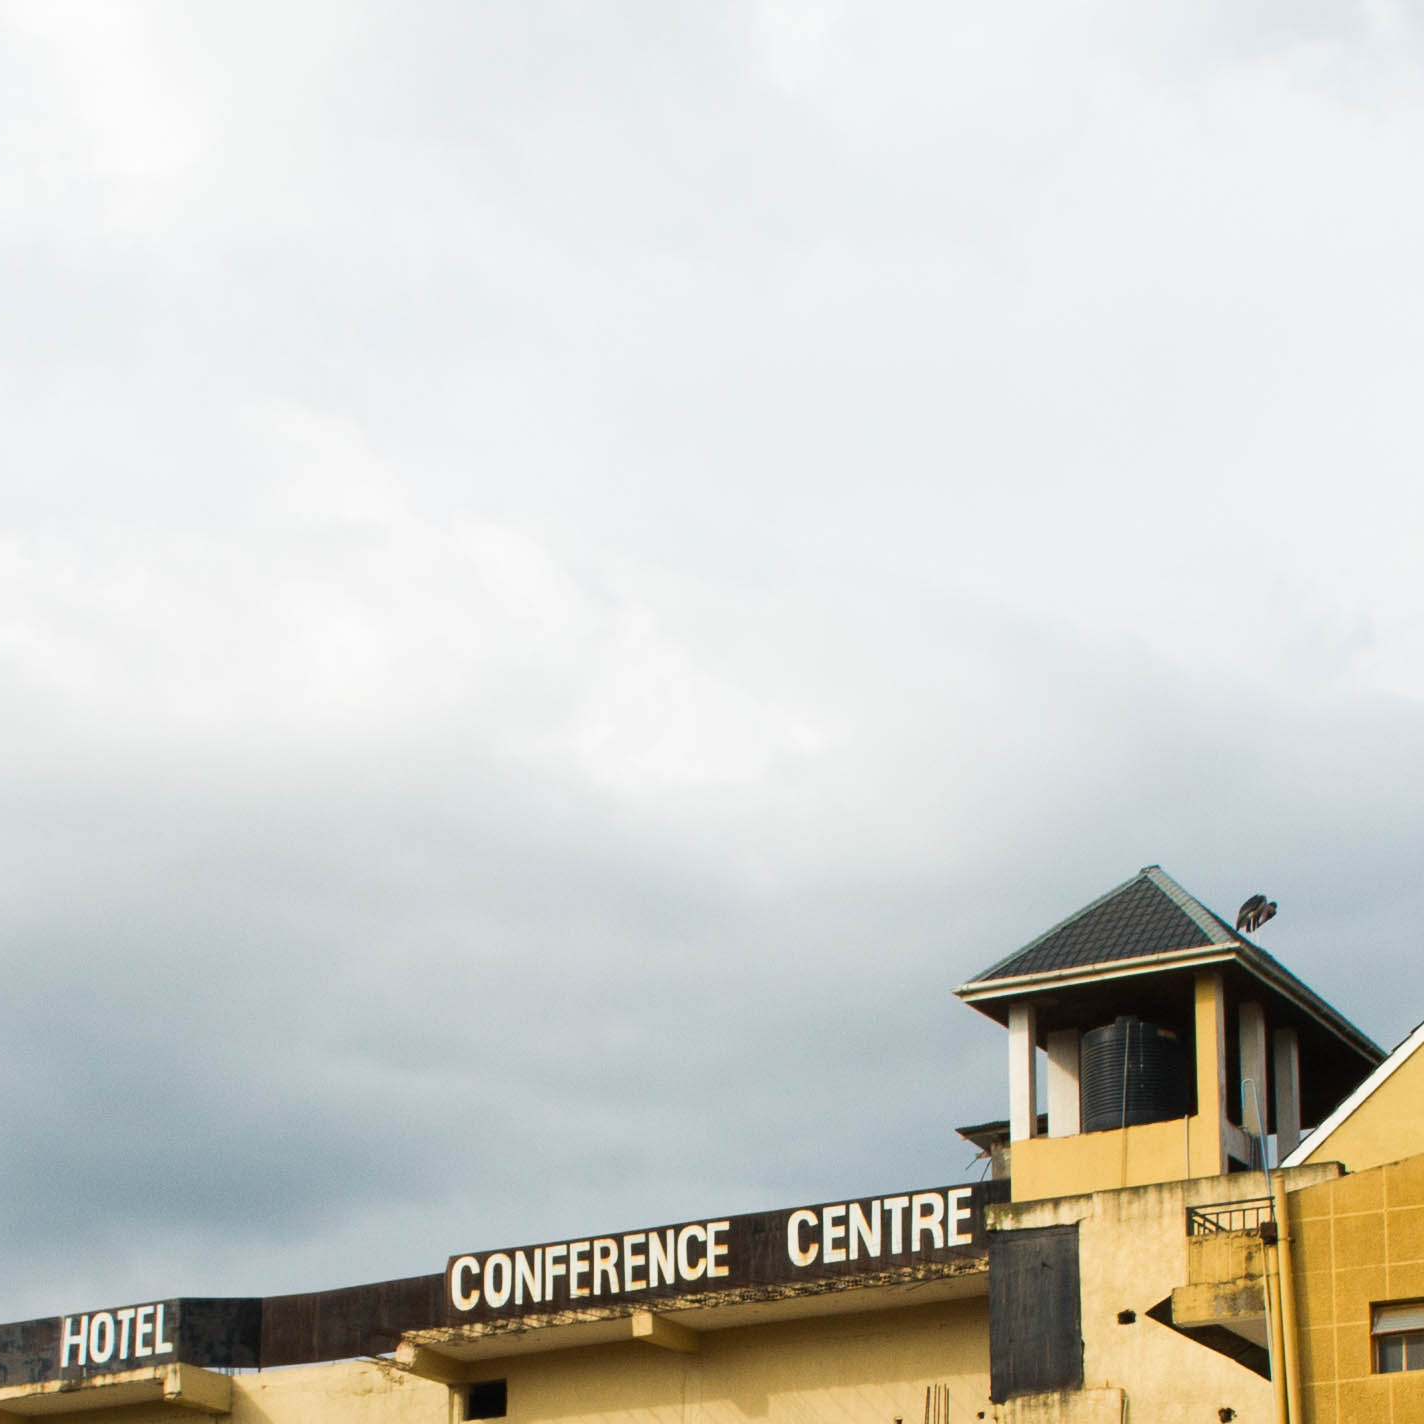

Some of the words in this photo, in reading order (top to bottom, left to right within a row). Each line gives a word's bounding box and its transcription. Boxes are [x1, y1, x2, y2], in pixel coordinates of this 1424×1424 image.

[60, 1303, 174, 1369] HOTEL
[450, 1220, 731, 1312] CONFERENCE
[786, 1187, 973, 1268] CENTRE
